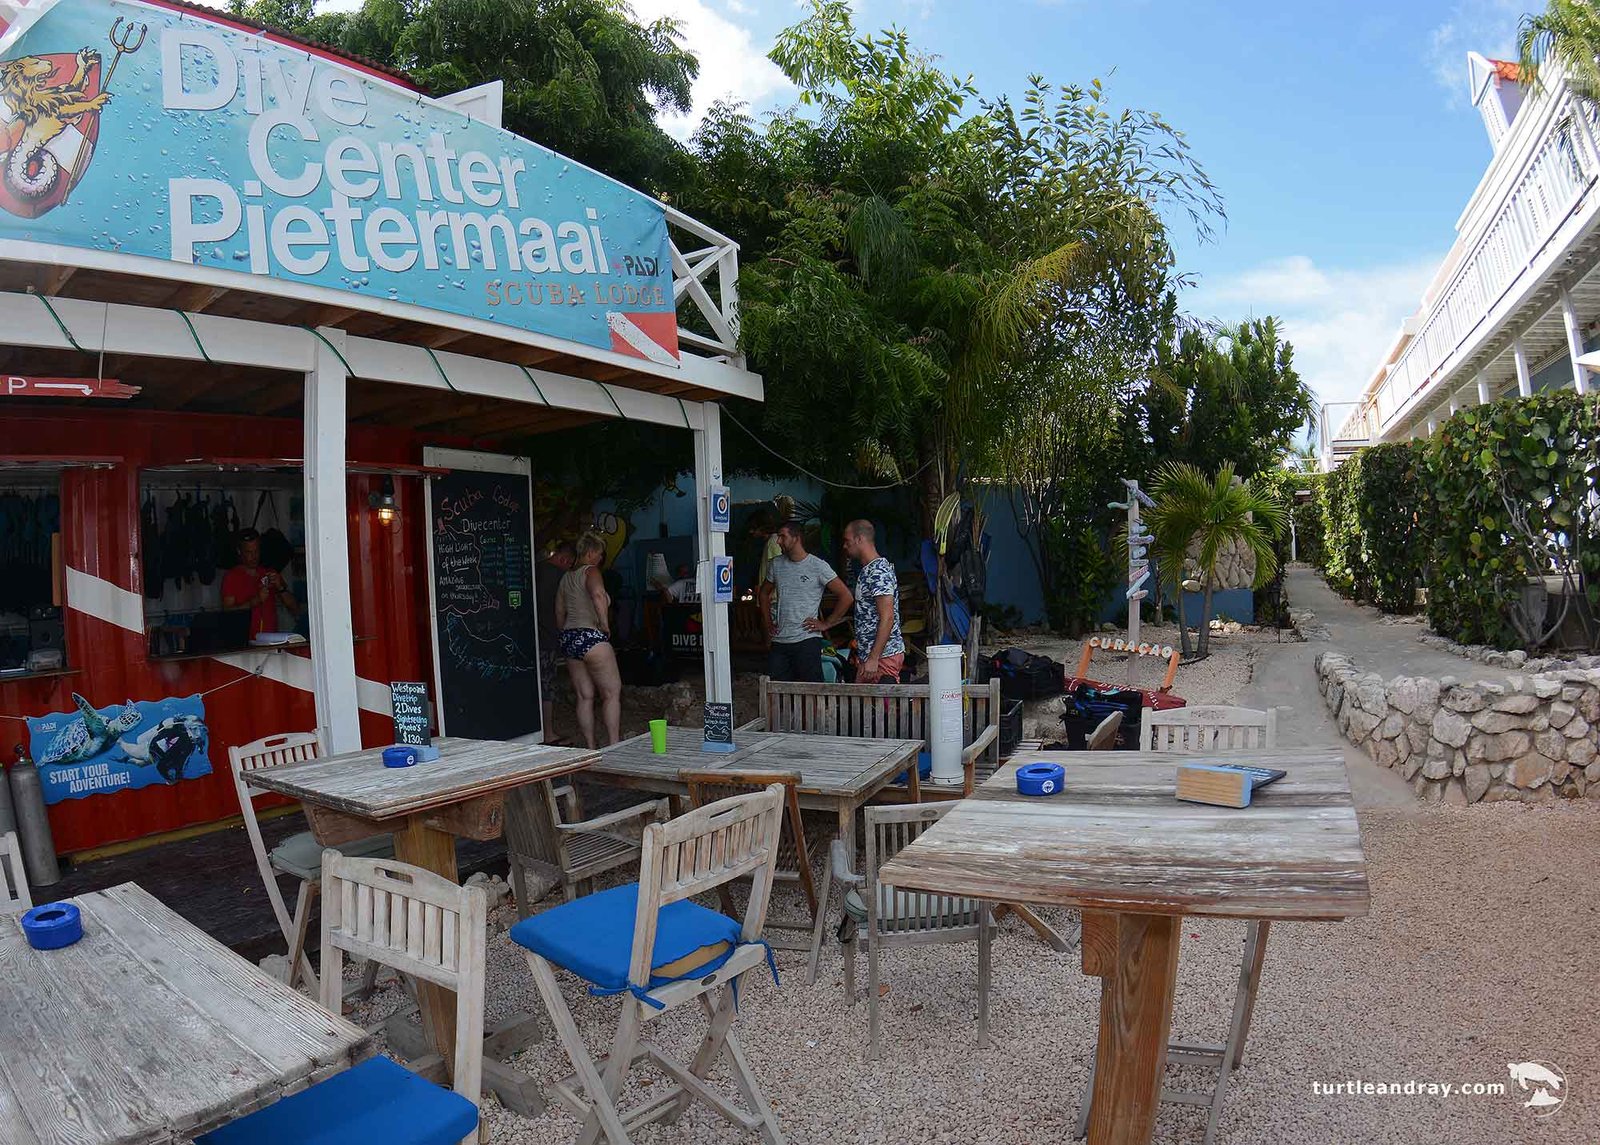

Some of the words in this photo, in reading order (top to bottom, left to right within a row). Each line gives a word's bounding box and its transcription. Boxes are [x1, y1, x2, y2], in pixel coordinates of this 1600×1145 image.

[161, 28, 368, 126] Dive
[248, 111, 526, 209] Center
[168, 177, 609, 275] Pietermaai
[624, 255, 659, 277] PADI
[485, 281, 586, 307] SCUBA
[594, 282, 667, 306] LODGE
[1089, 636, 1173, 659] CURAÇAO
[391, 683, 426, 696] Westpoint
[50, 767, 82, 785] START
[82, 763, 110, 777] YOUR
[69, 771, 130, 794] ADVENTURE!
